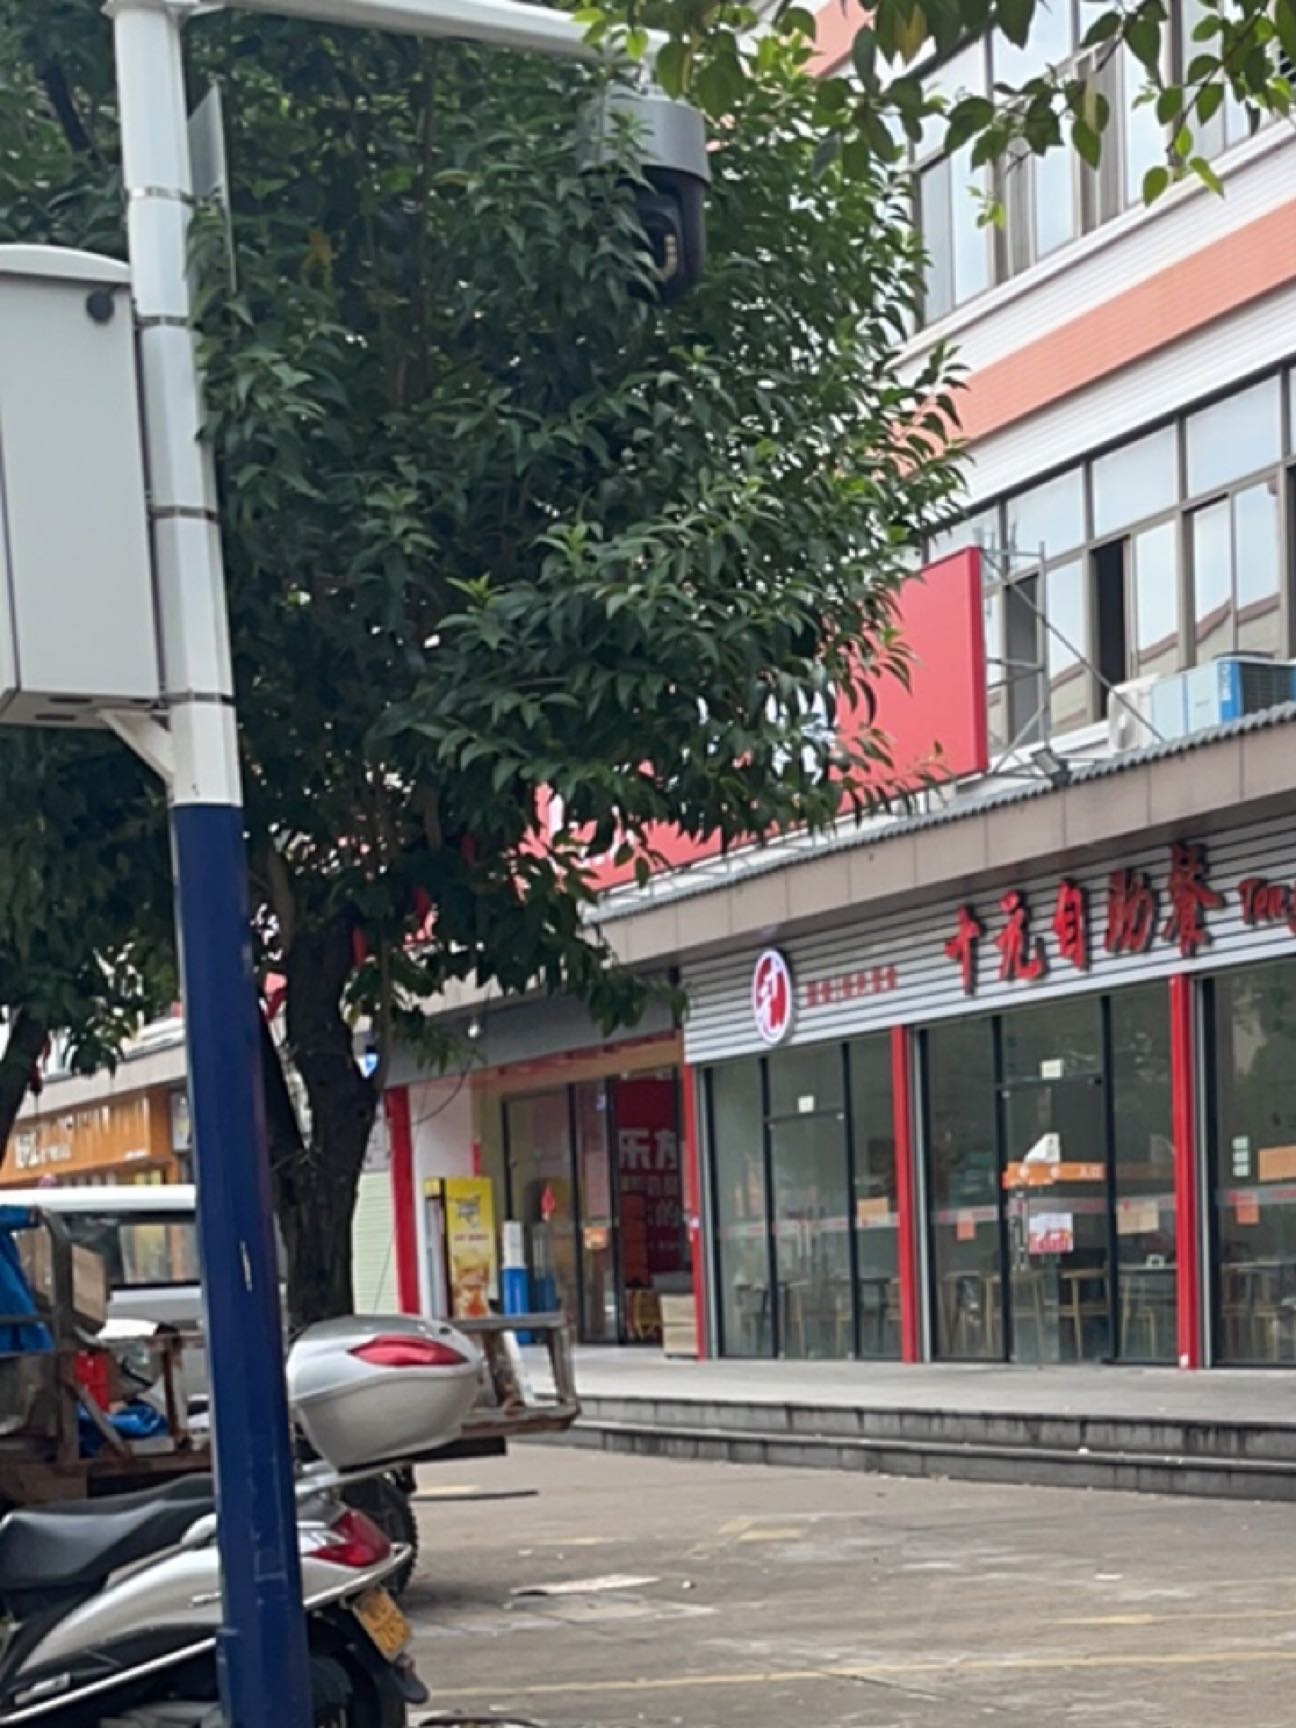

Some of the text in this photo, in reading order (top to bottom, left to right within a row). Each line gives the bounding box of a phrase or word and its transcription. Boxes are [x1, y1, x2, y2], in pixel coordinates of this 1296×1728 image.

[944, 843, 1226, 996] 十元自助餐
